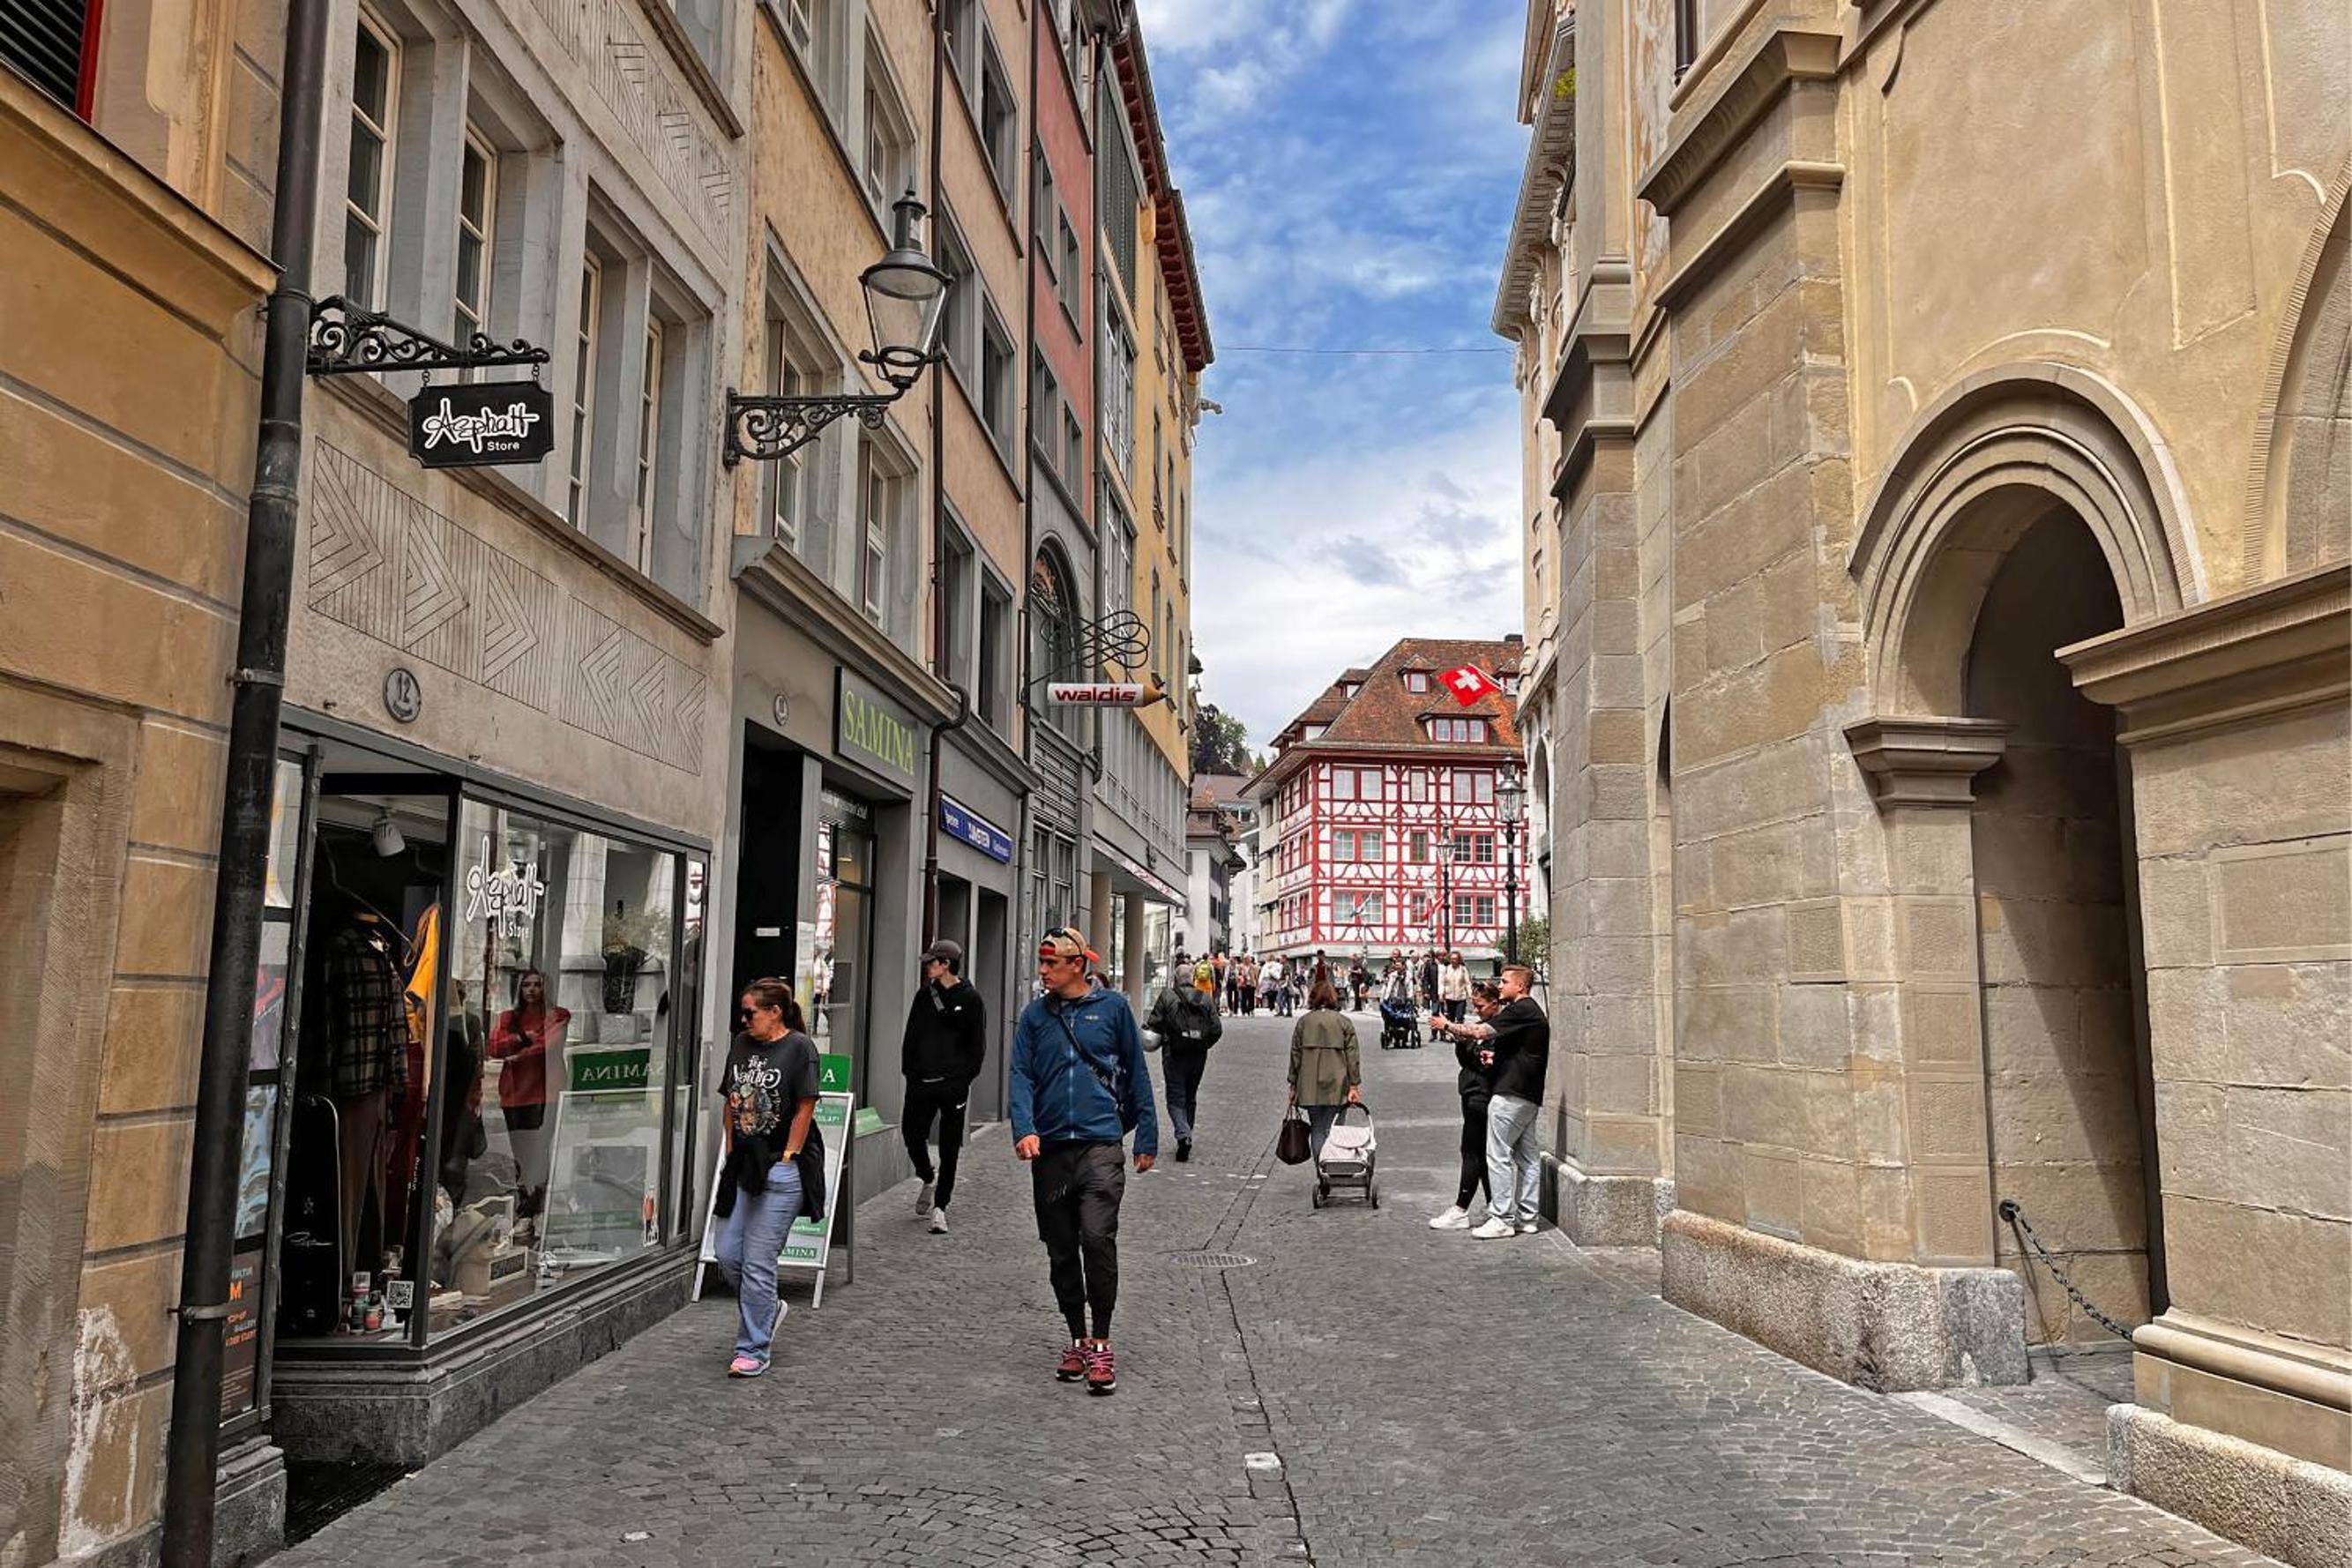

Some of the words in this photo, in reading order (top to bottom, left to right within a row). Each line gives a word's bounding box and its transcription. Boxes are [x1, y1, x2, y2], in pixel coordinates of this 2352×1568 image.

[487, 442, 520, 452] Store
[397, 673, 411, 703] 12
[1055, 687, 1137, 702] waldis
[845, 691, 915, 776] SAMINA
